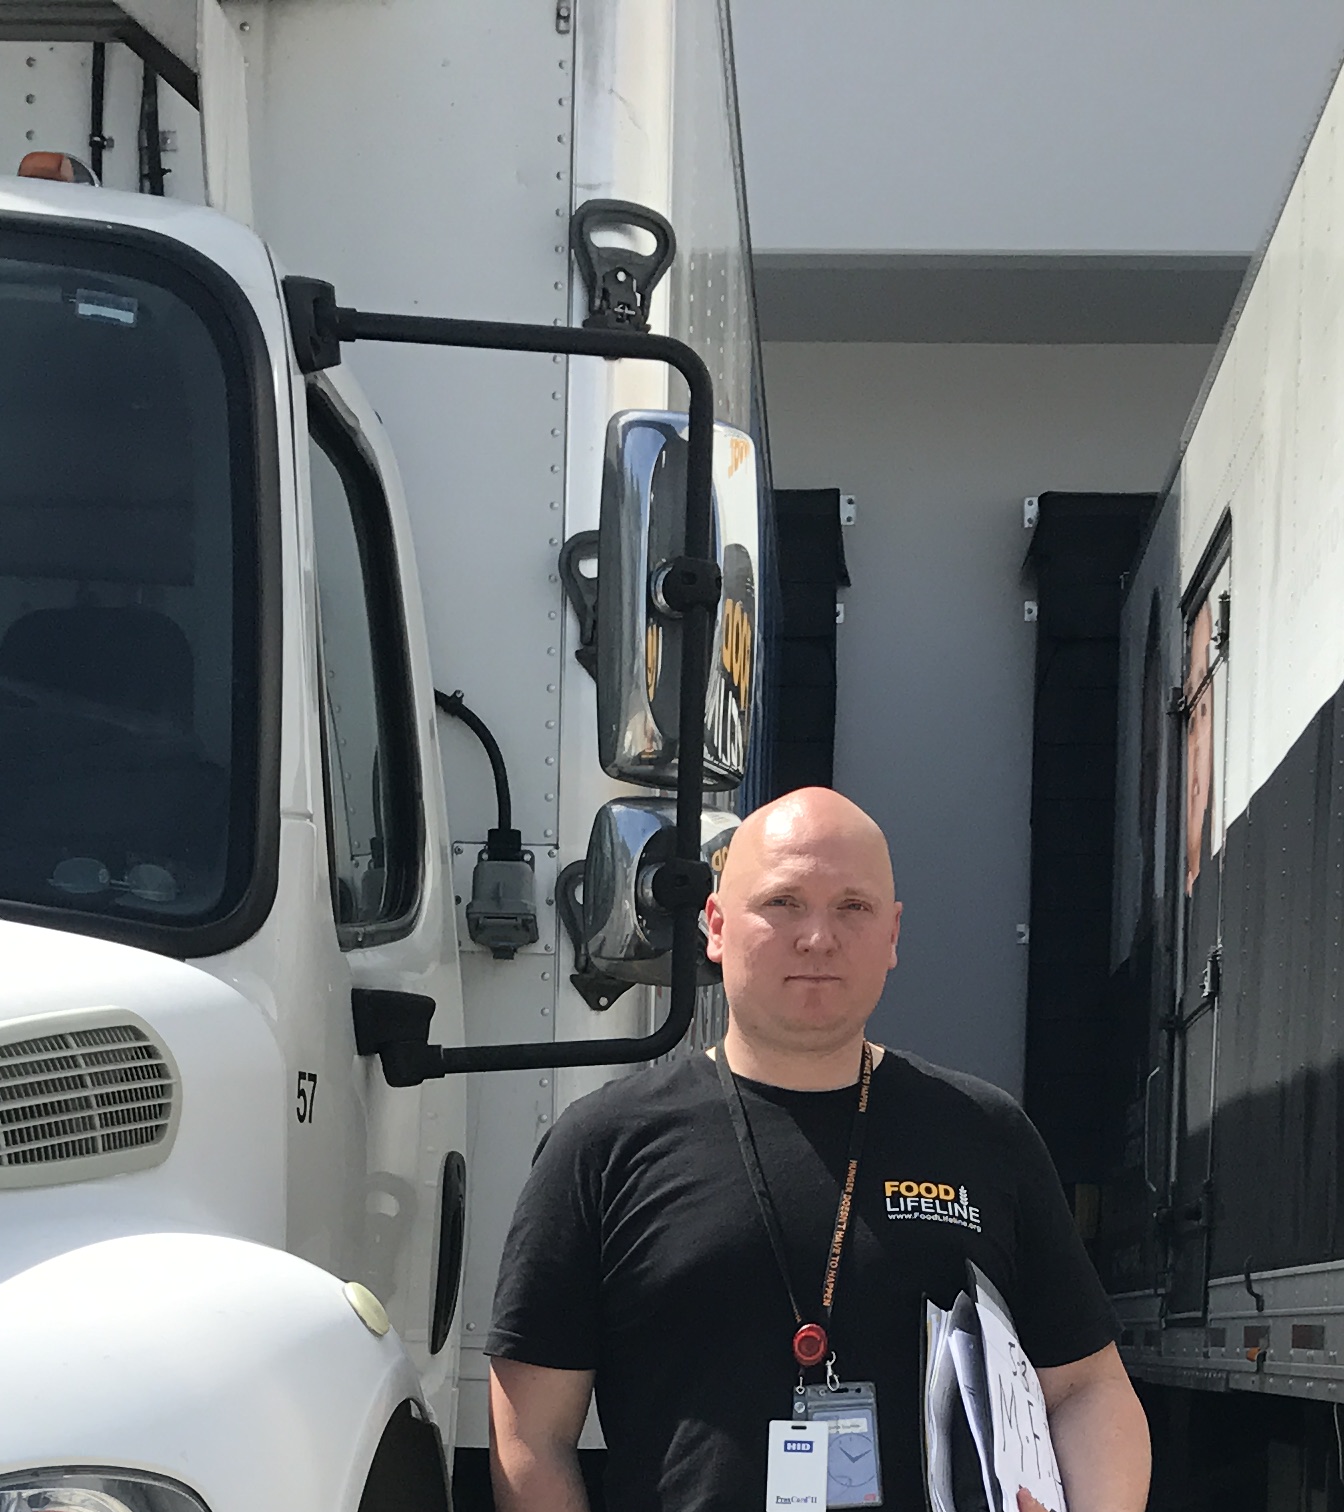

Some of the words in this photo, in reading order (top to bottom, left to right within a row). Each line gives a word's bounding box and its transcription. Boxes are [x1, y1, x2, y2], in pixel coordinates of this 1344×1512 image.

[297, 1071, 317, 1124] 57
[845, 1159, 858, 1193] HUNGER
[884, 1181, 955, 1201] FOOD
[886, 1197, 981, 1224] LIFELINE
[832, 1231, 845, 1255] HAVE
[829, 1256, 840, 1269] TO
[822, 1269, 836, 1307] HAPPEN
[786, 1442, 812, 1452] HID
